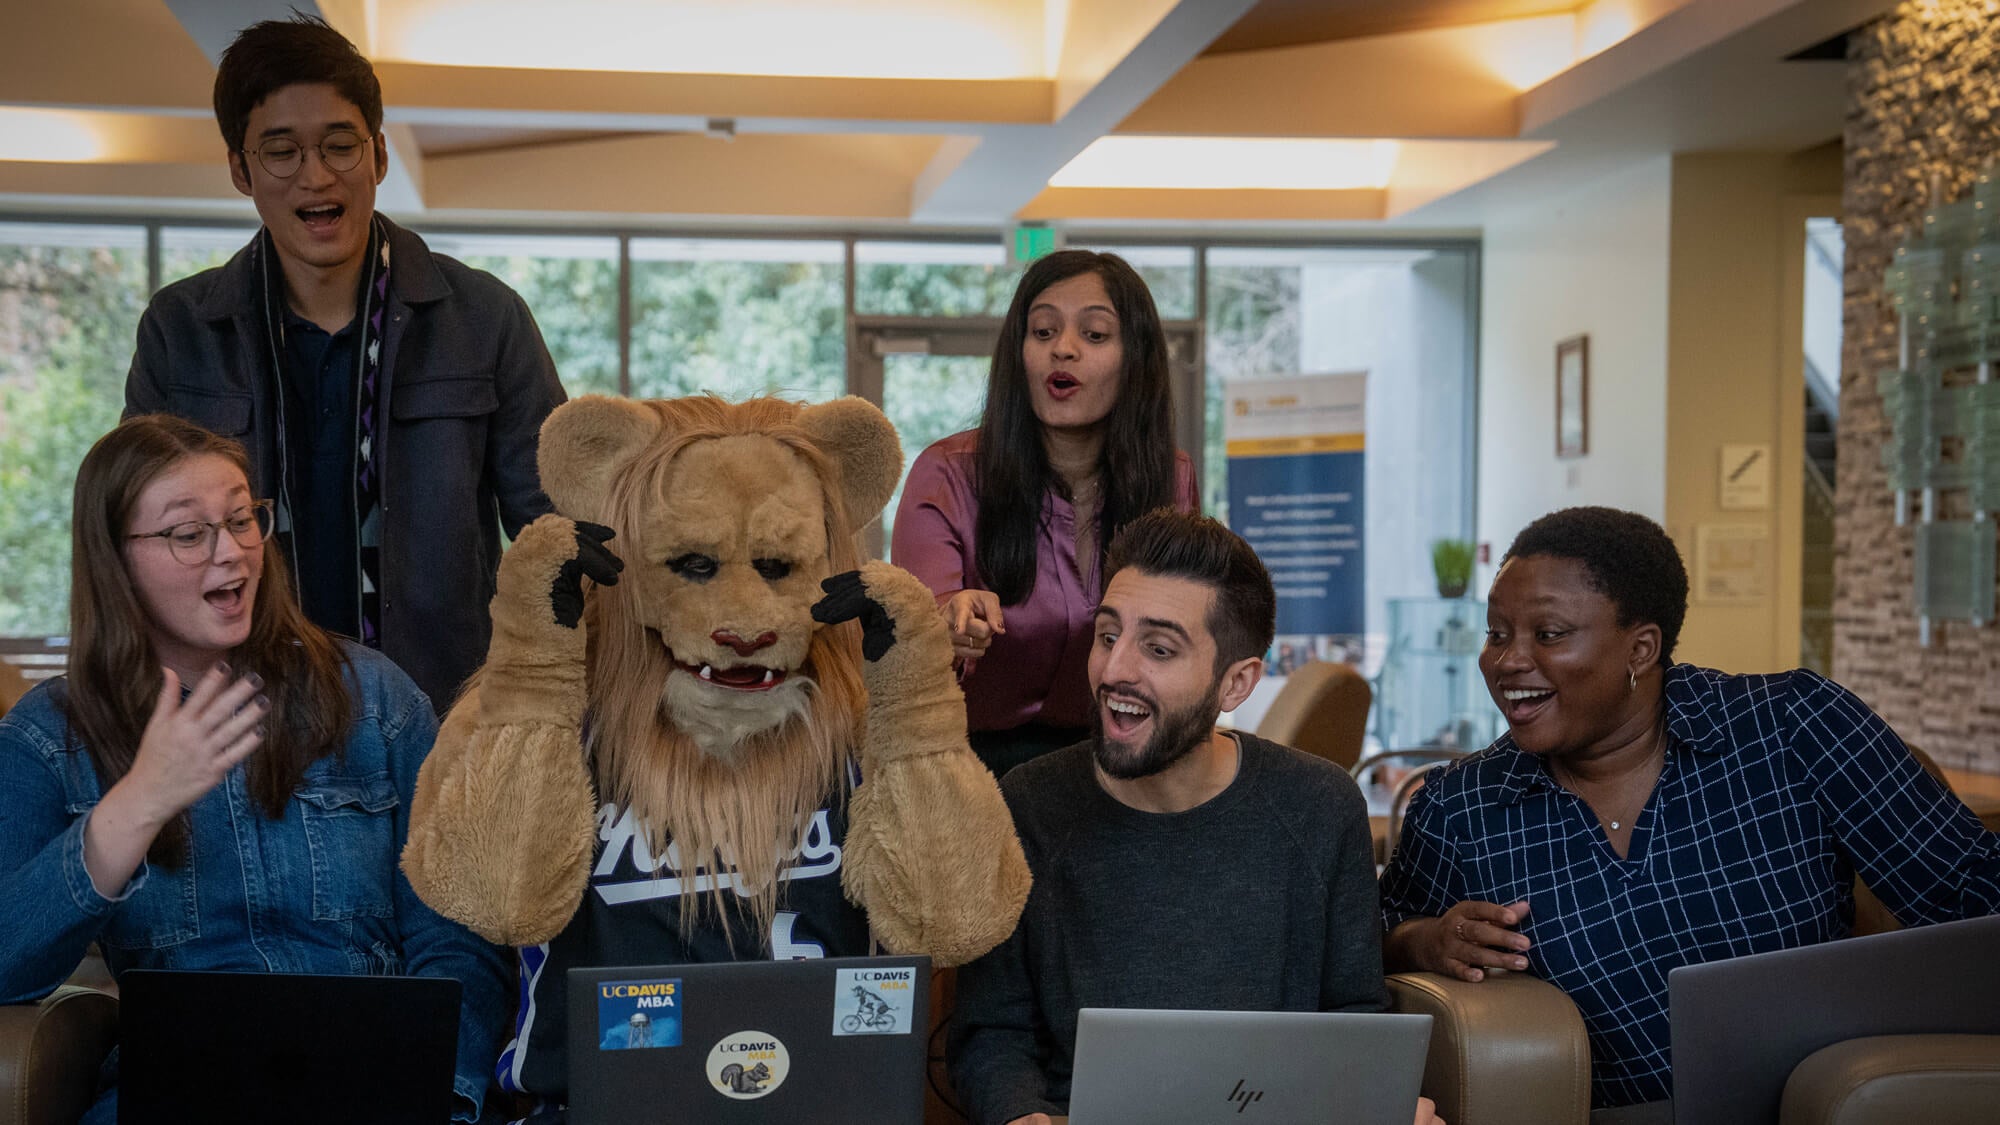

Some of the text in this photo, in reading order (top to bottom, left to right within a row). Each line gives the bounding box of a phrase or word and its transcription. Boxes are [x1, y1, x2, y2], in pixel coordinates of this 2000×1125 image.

[880, 981, 909, 990] MBA
[636, 996, 675, 1009] MBA
[747, 1051, 777, 1060] MBA
[1227, 1079, 1264, 1113] hp
